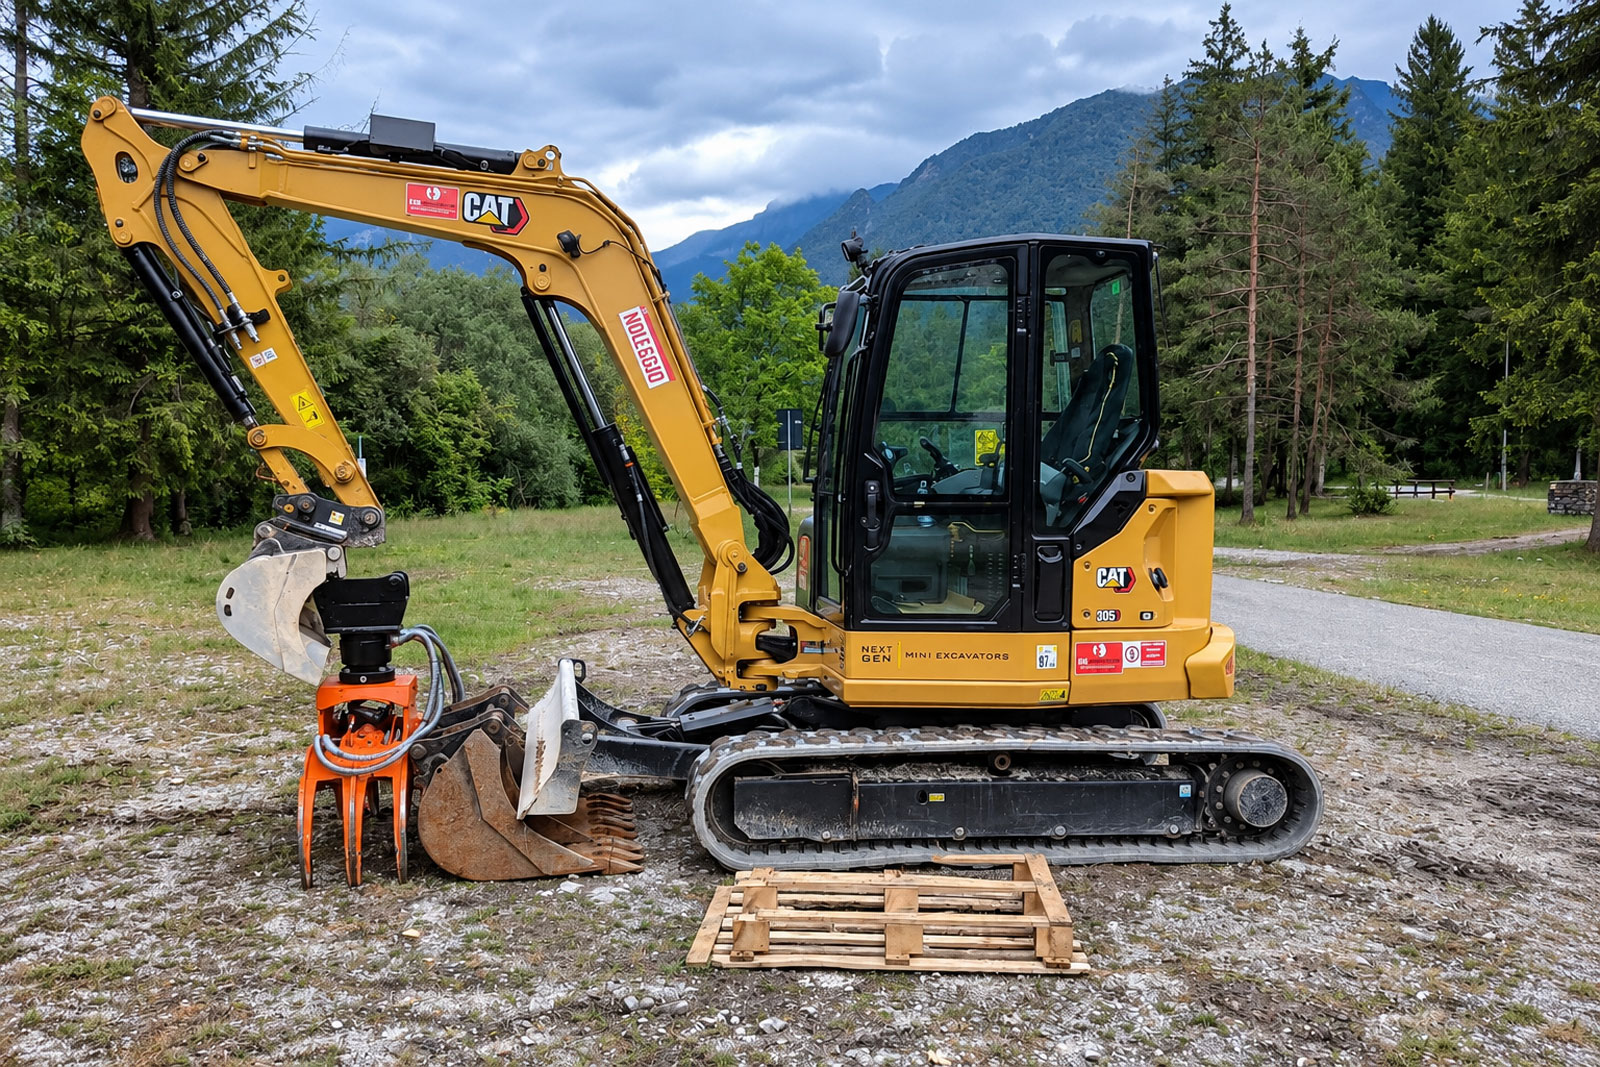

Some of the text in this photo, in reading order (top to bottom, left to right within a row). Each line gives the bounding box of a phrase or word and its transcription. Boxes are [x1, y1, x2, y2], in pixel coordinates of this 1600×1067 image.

[463, 192, 514, 226] CAT
[1096, 567, 1127, 588] CAT
[1096, 610, 1116, 621] 305
[861, 645, 893, 653] NEXT
[861, 654, 891, 663] GEN
[905, 651, 1009, 660] MINI EXCAVATORS
